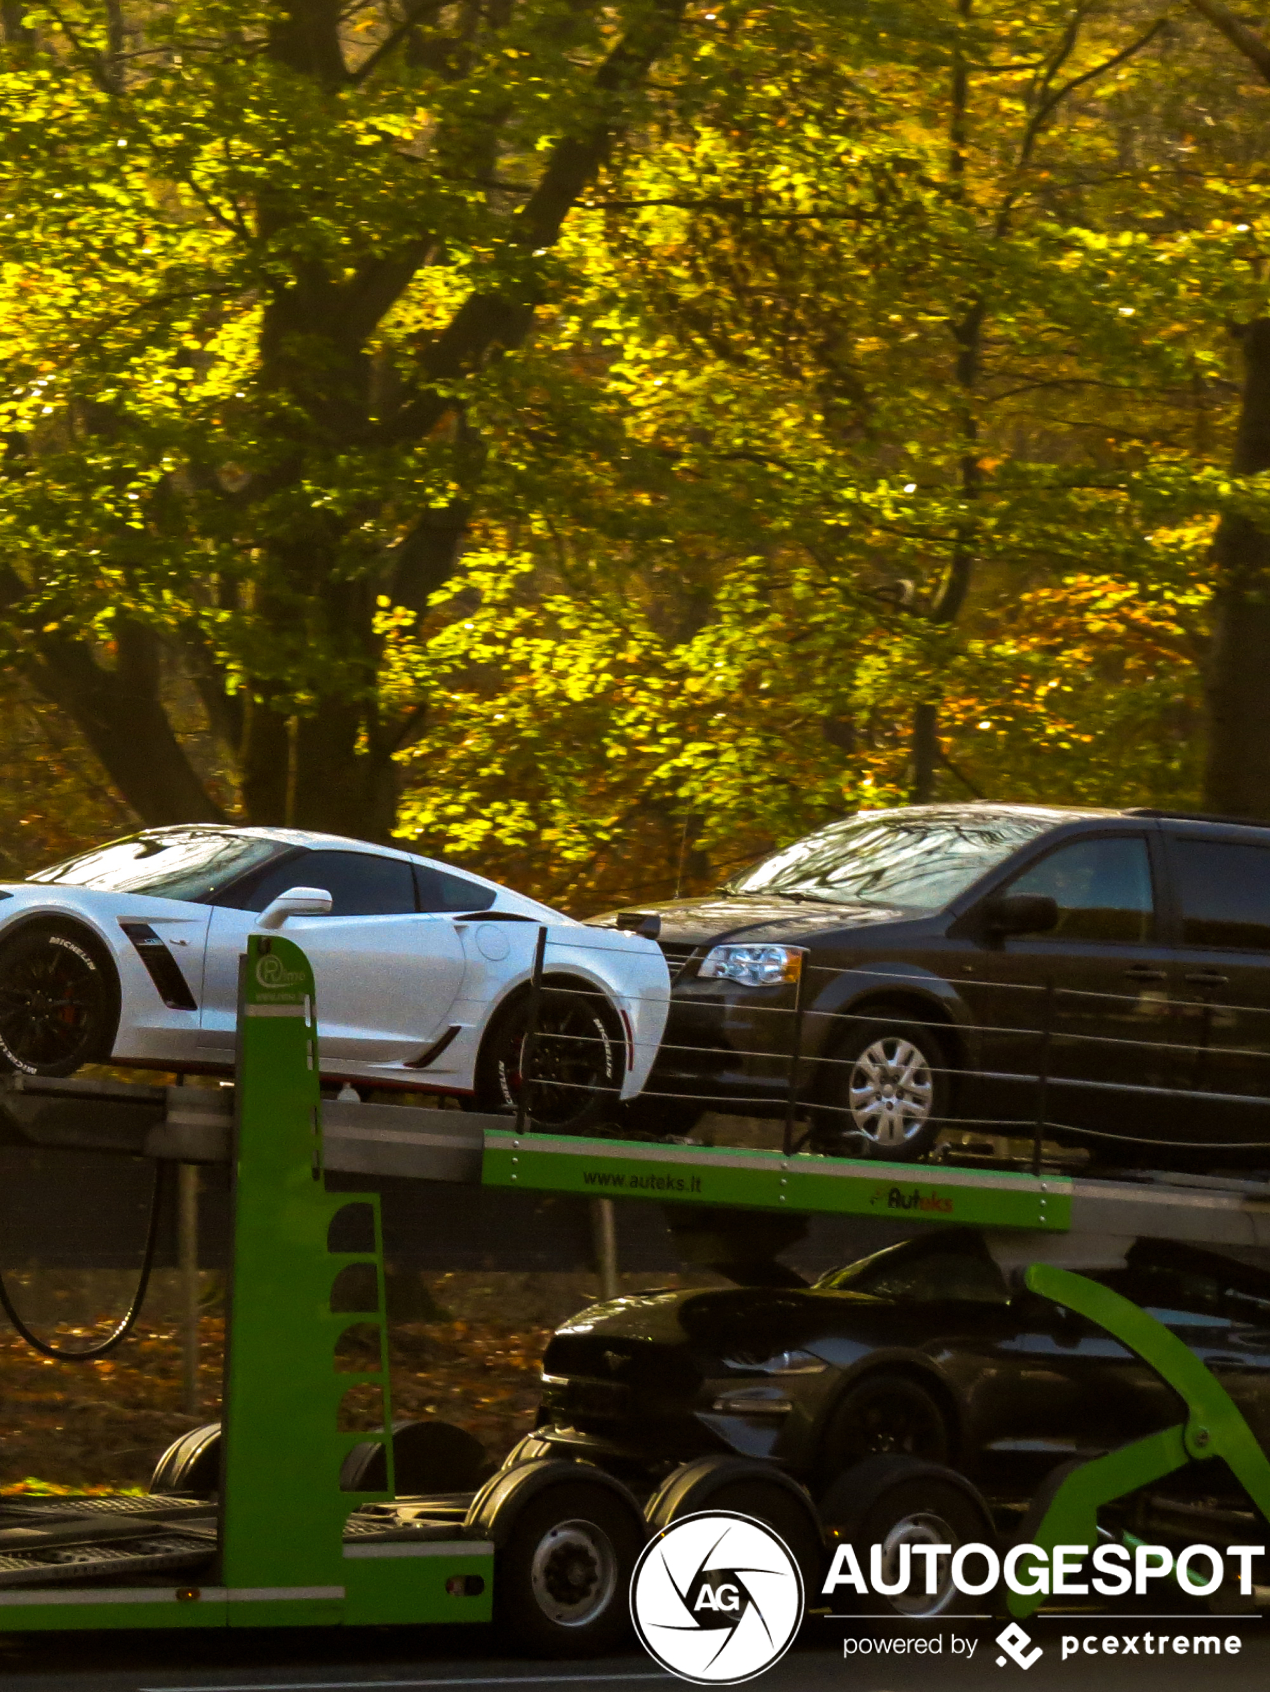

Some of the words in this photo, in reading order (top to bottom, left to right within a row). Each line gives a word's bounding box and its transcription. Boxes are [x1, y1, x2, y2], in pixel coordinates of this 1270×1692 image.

[49, 936, 96, 970] MICHELIN
[593, 1018, 612, 1079] MICHELIN
[583, 1171, 701, 1193] www.auteks.lt
[888, 1187, 954, 1213] Auteks
